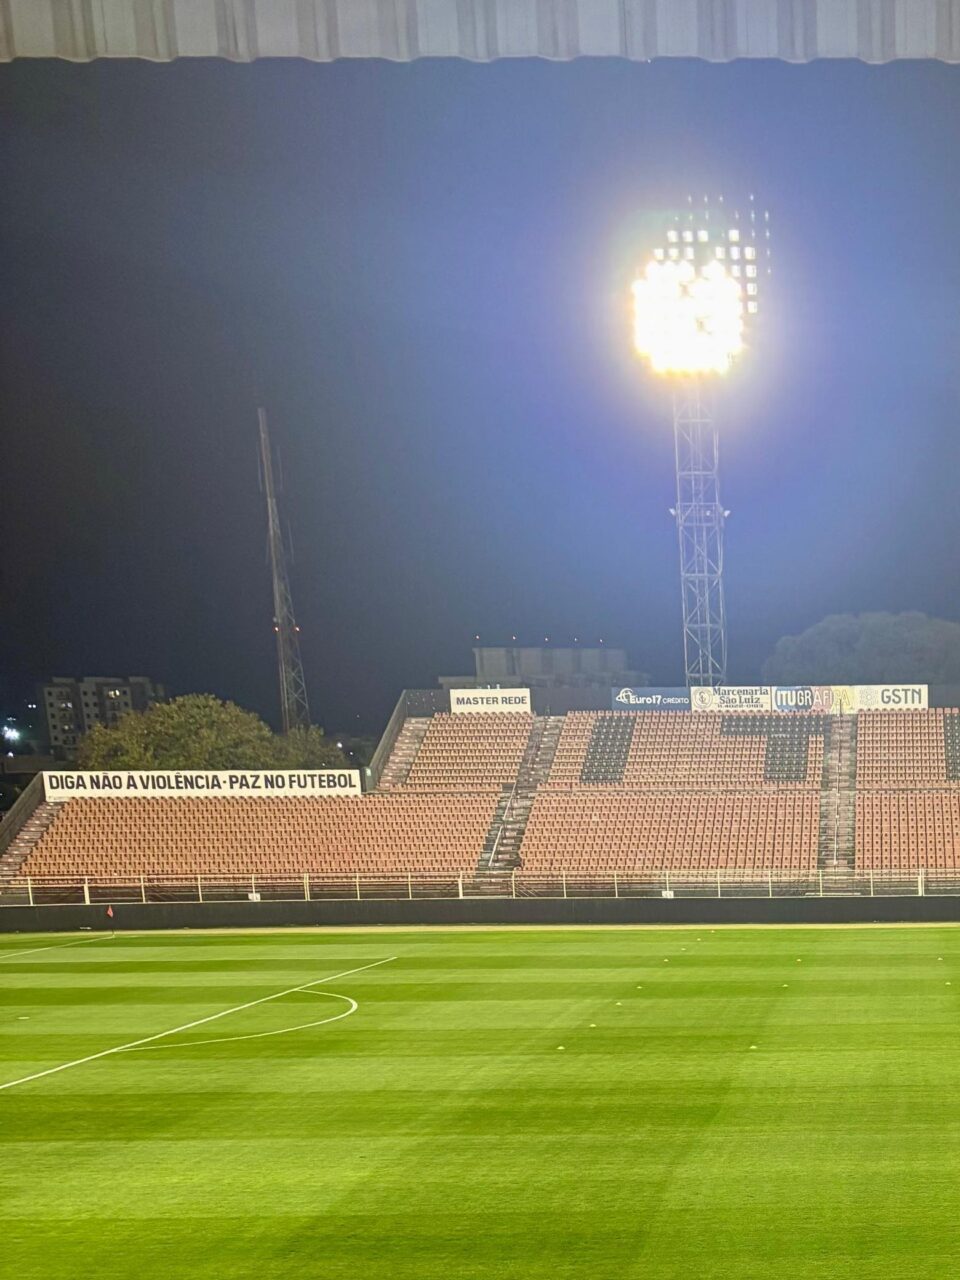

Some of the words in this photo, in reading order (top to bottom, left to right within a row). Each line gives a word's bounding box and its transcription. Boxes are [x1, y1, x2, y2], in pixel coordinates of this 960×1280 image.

[713, 687, 768, 696] Marcenaria
[881, 688, 922, 705] GSTN
[456, 696, 498, 706] MASTER
[501, 695, 527, 705] REDE
[629, 695, 662, 705] Euro17
[720, 695, 737, 704] São
[739, 695, 761, 704] Luiz
[49, 774, 87, 790] DIGA
[90, 772, 122, 789] NÃO
[229, 774, 261, 789] PAZ
[265, 774, 286, 788] NO
[289, 773, 357, 788] FUTEBOL
